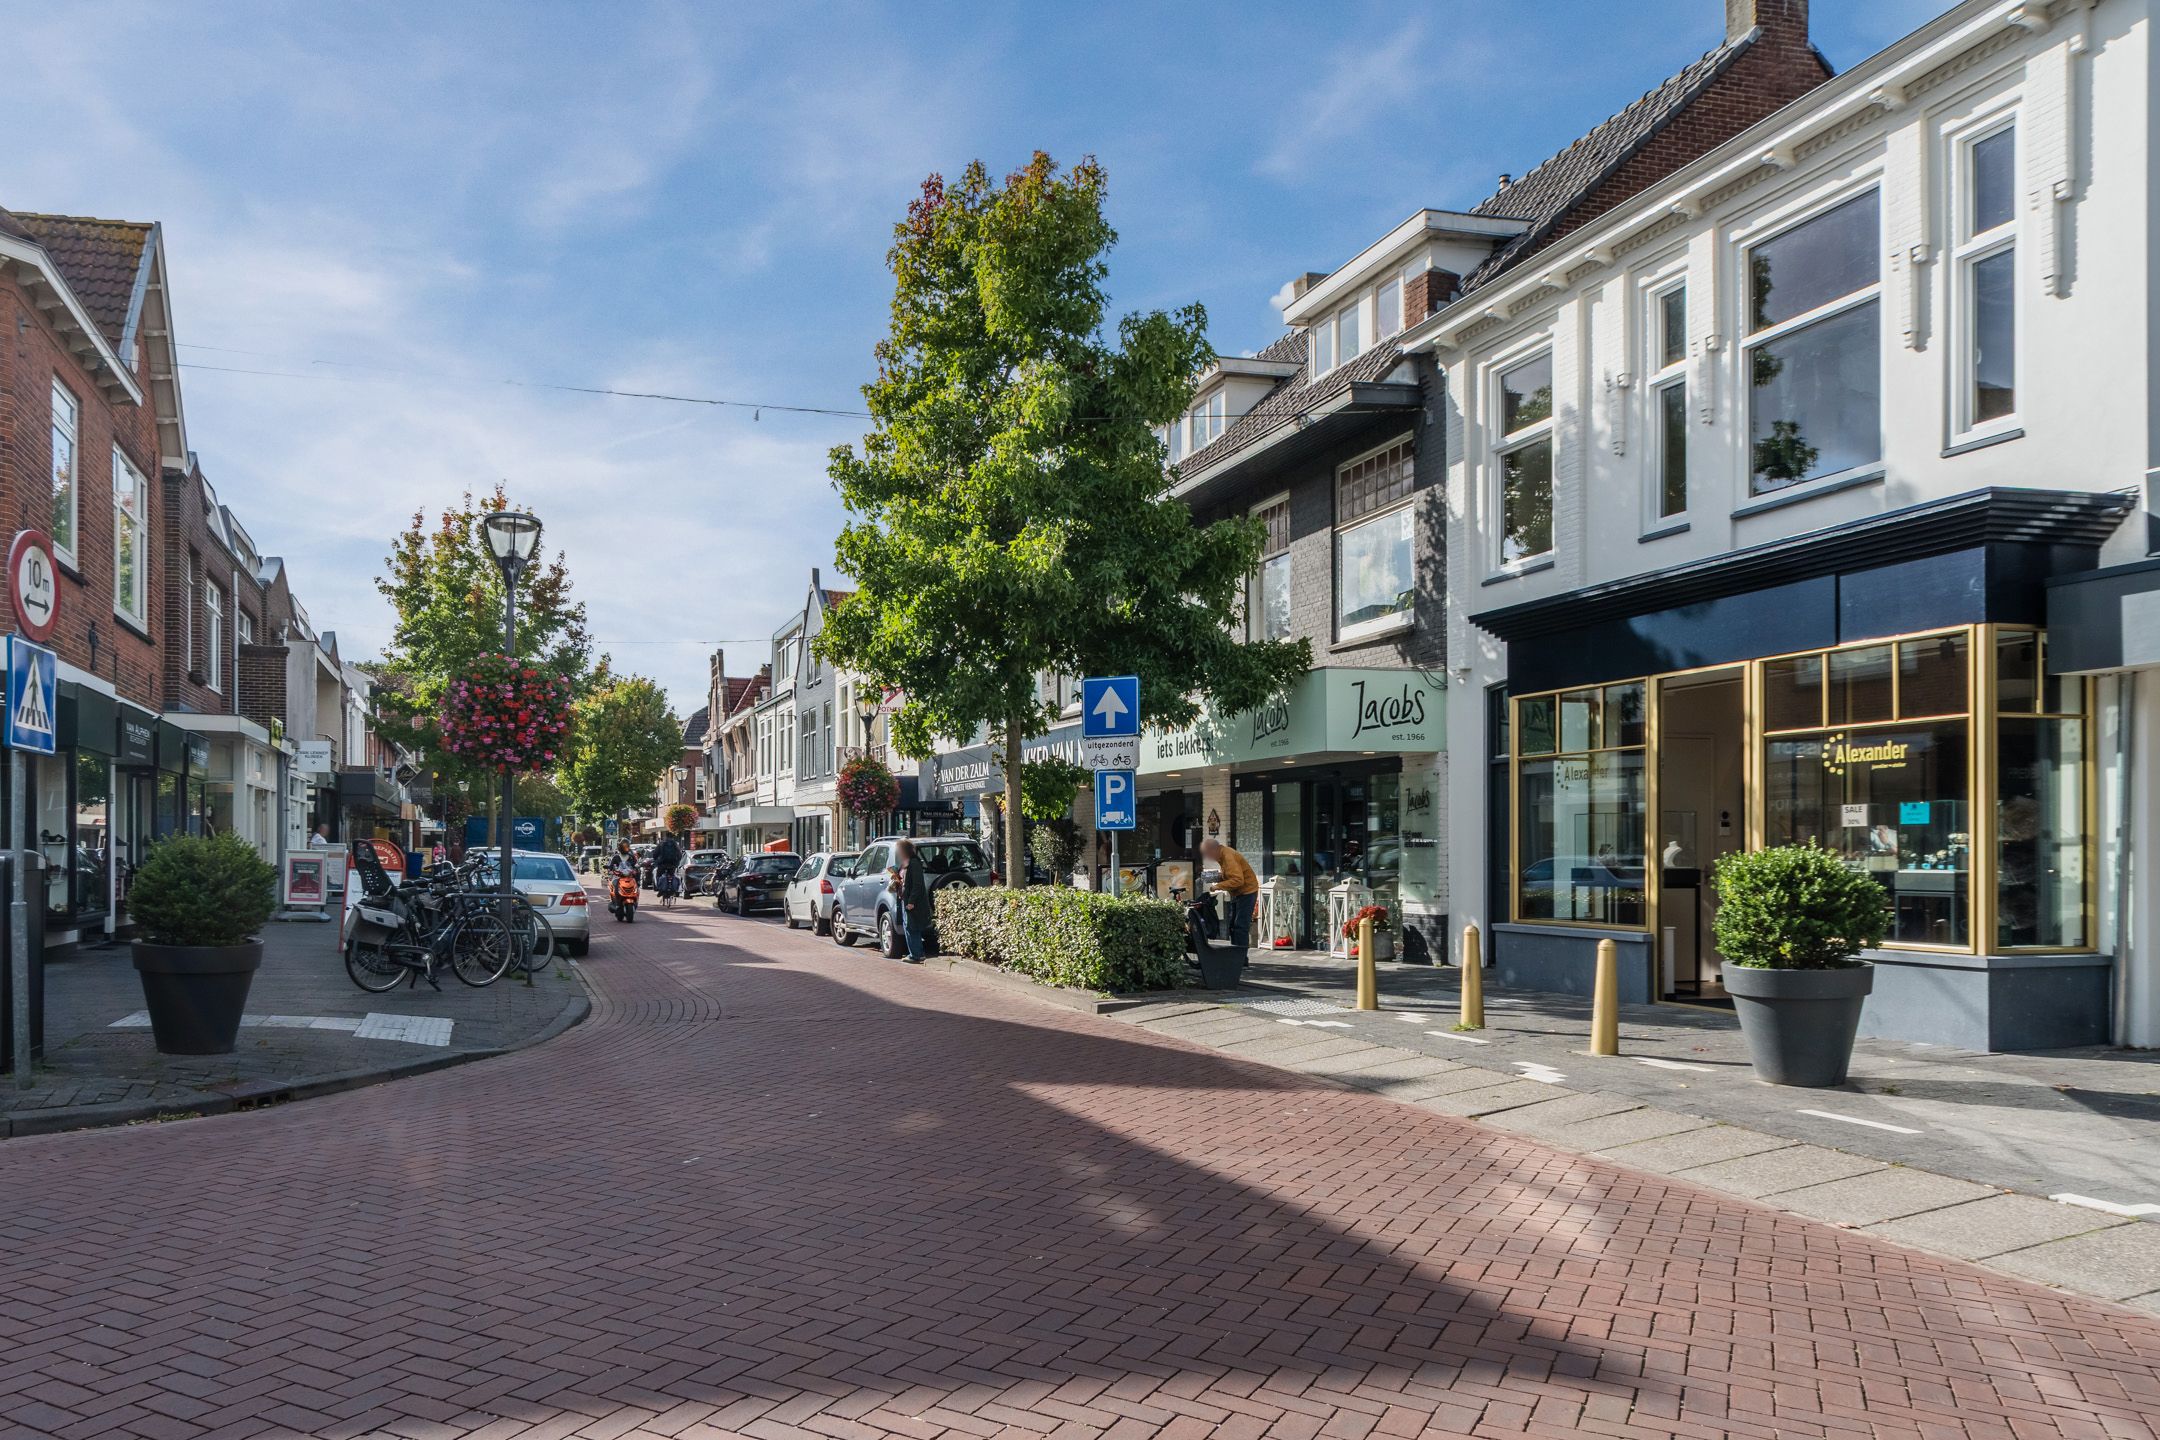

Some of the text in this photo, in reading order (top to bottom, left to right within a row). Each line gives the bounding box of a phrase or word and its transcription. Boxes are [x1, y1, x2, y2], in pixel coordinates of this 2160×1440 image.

[1352, 681, 1425, 739] Jacobs
[1051, 740, 1074, 767] VAN
[1087, 740, 1135, 750] uitgezonderd
[1157, 730, 1214, 759] iets lekkers!
[1834, 740, 1909, 764] Alexander
[940, 761, 990, 783] VAN DER ZALM
[1106, 775, 1126, 804] P
[1405, 787, 1430, 816] Jacobs
